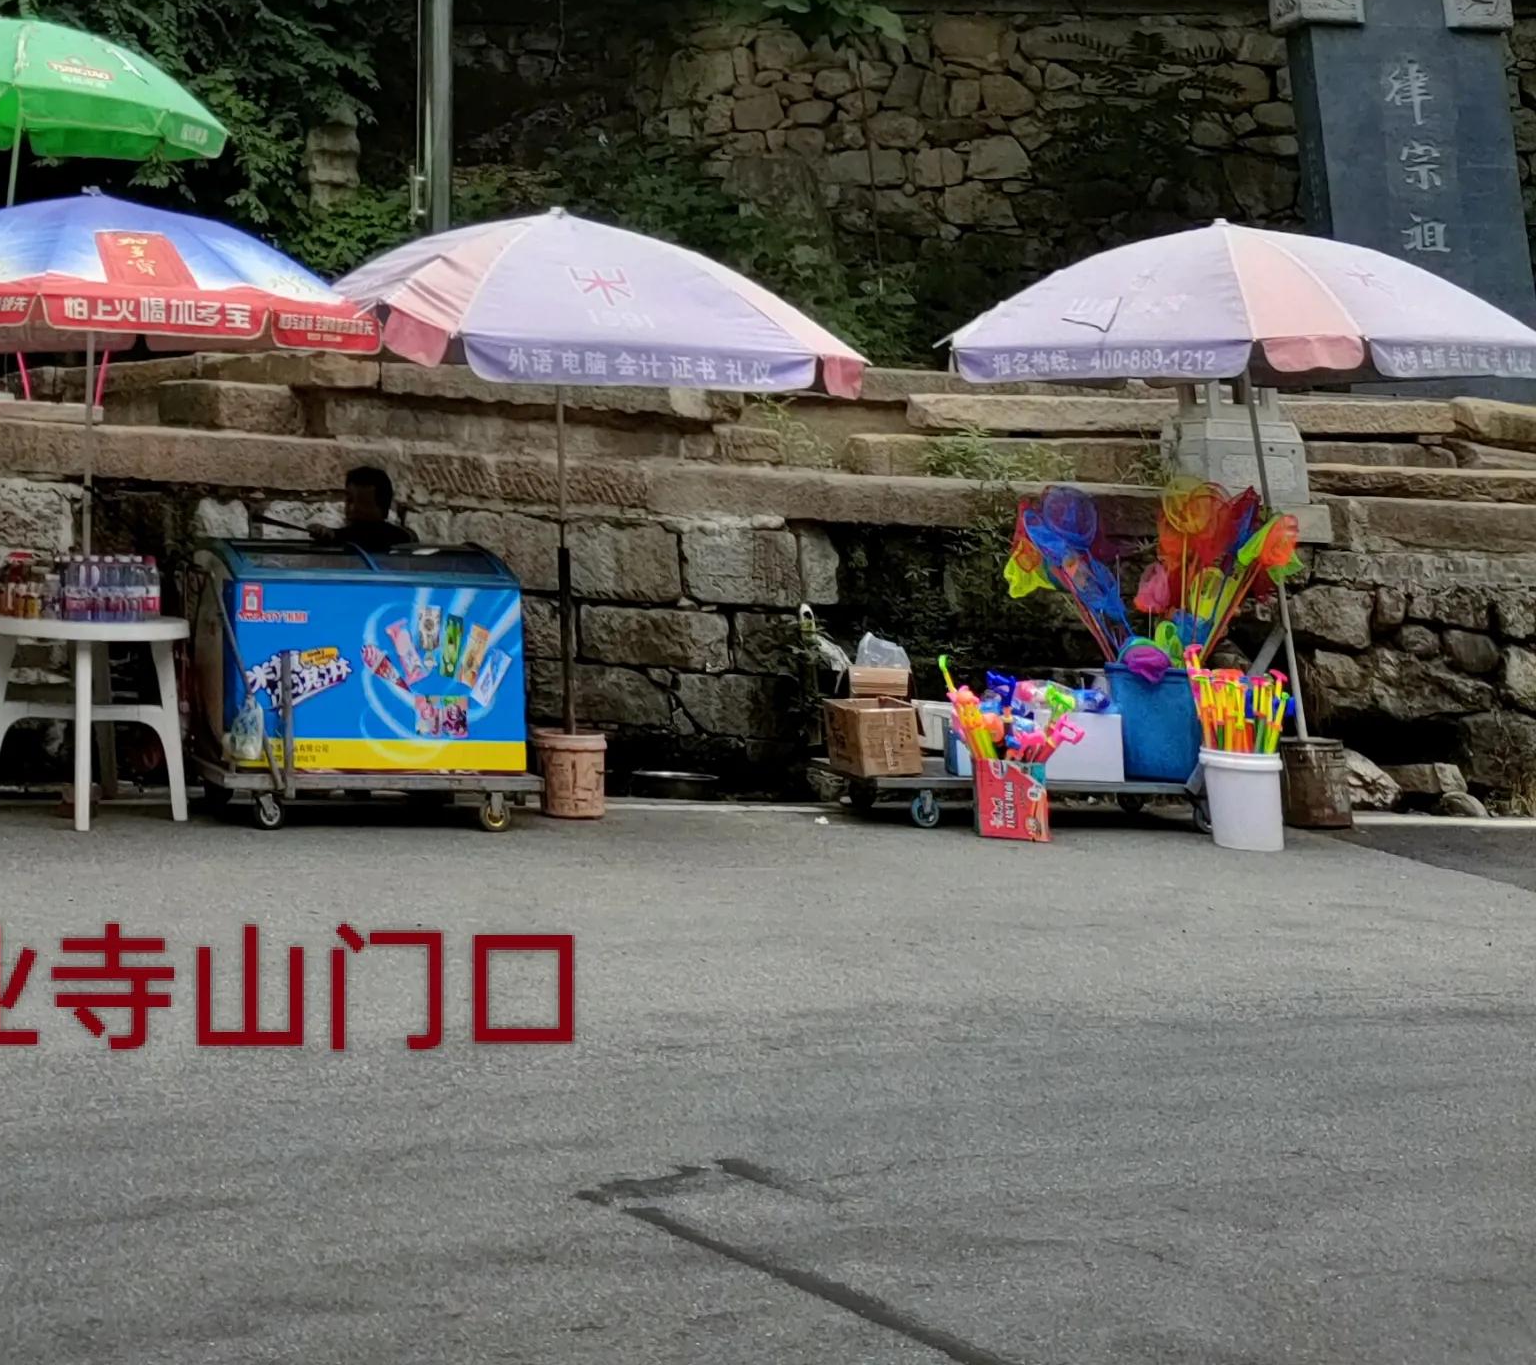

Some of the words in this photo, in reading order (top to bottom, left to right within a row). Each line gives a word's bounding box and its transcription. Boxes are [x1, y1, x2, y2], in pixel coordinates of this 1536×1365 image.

[64, 296, 252, 330] 怕上火喝加多宝
[507, 348, 553, 374] 外语
[561, 350, 607, 375] 电脑
[614, 352, 662, 377] 会计
[670, 355, 717, 381] 证书
[725, 361, 775, 385] 礼仪
[1089, 348, 1216, 371] 400-889-1212
